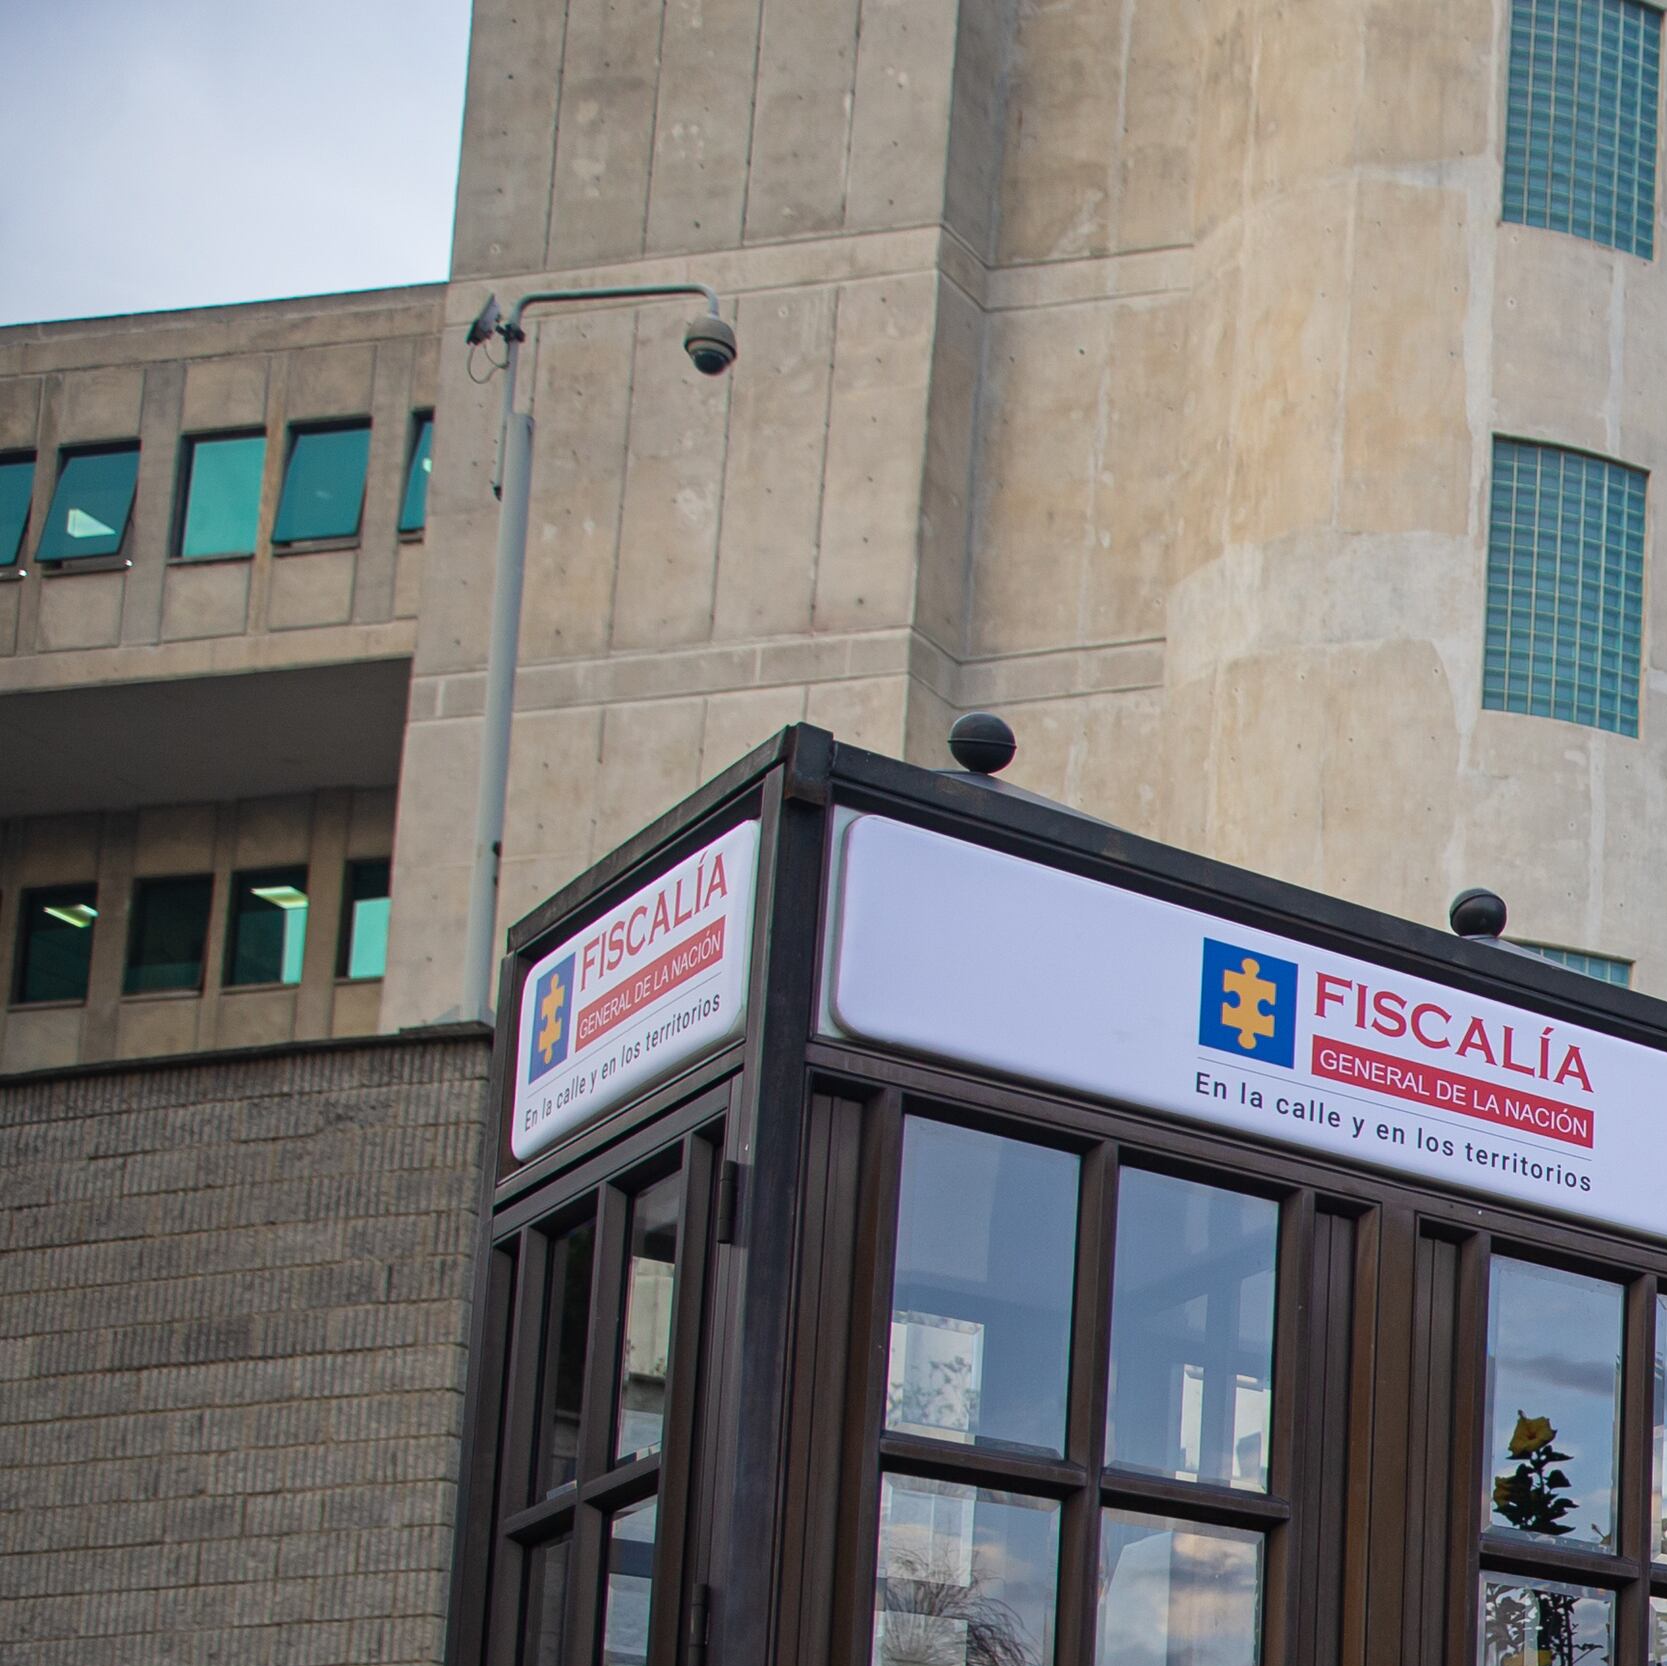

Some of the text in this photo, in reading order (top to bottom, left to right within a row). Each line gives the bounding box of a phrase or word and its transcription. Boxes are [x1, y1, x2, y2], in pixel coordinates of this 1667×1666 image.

[580, 851, 728, 993] FISCALÍA
[579, 929, 721, 1039] GENERAL DE LA NACIÓN
[1314, 971, 1594, 1093] FISCALÍA
[525, 993, 720, 1132] En la calle y en los territorios
[1319, 1049, 1587, 1138] GENERAL DE LA NACIÓN
[1195, 1071, 1591, 1192] En la calle y en los territorios
